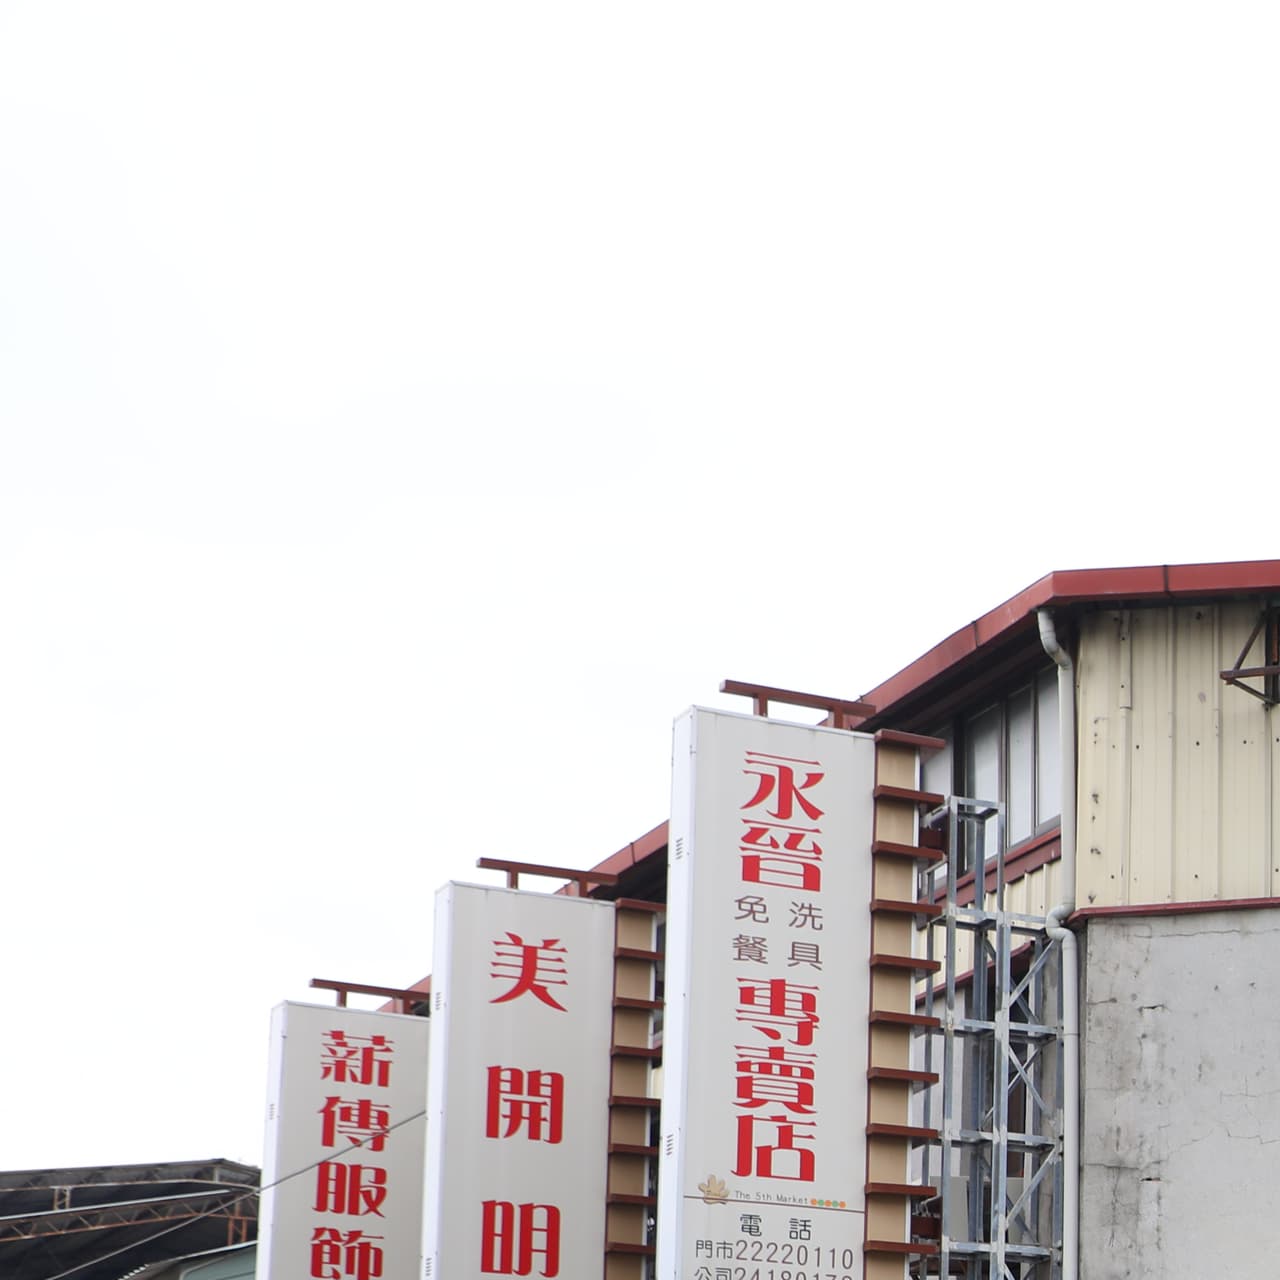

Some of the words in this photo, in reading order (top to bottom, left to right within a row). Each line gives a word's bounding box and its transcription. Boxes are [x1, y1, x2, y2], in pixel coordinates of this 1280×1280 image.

[739, 750, 825, 893] 永晉
[734, 895, 824, 931] 免洗
[732, 933, 824, 971] 餐具
[731, 977, 821, 1183] 專賣店
[480, 932, 569, 1279] 美開明
[735, 1190, 751, 1200] The
[755, 1192, 770, 1201] 5th
[777, 1194, 809, 1205] Market
[740, 1214, 812, 1241] 電話
